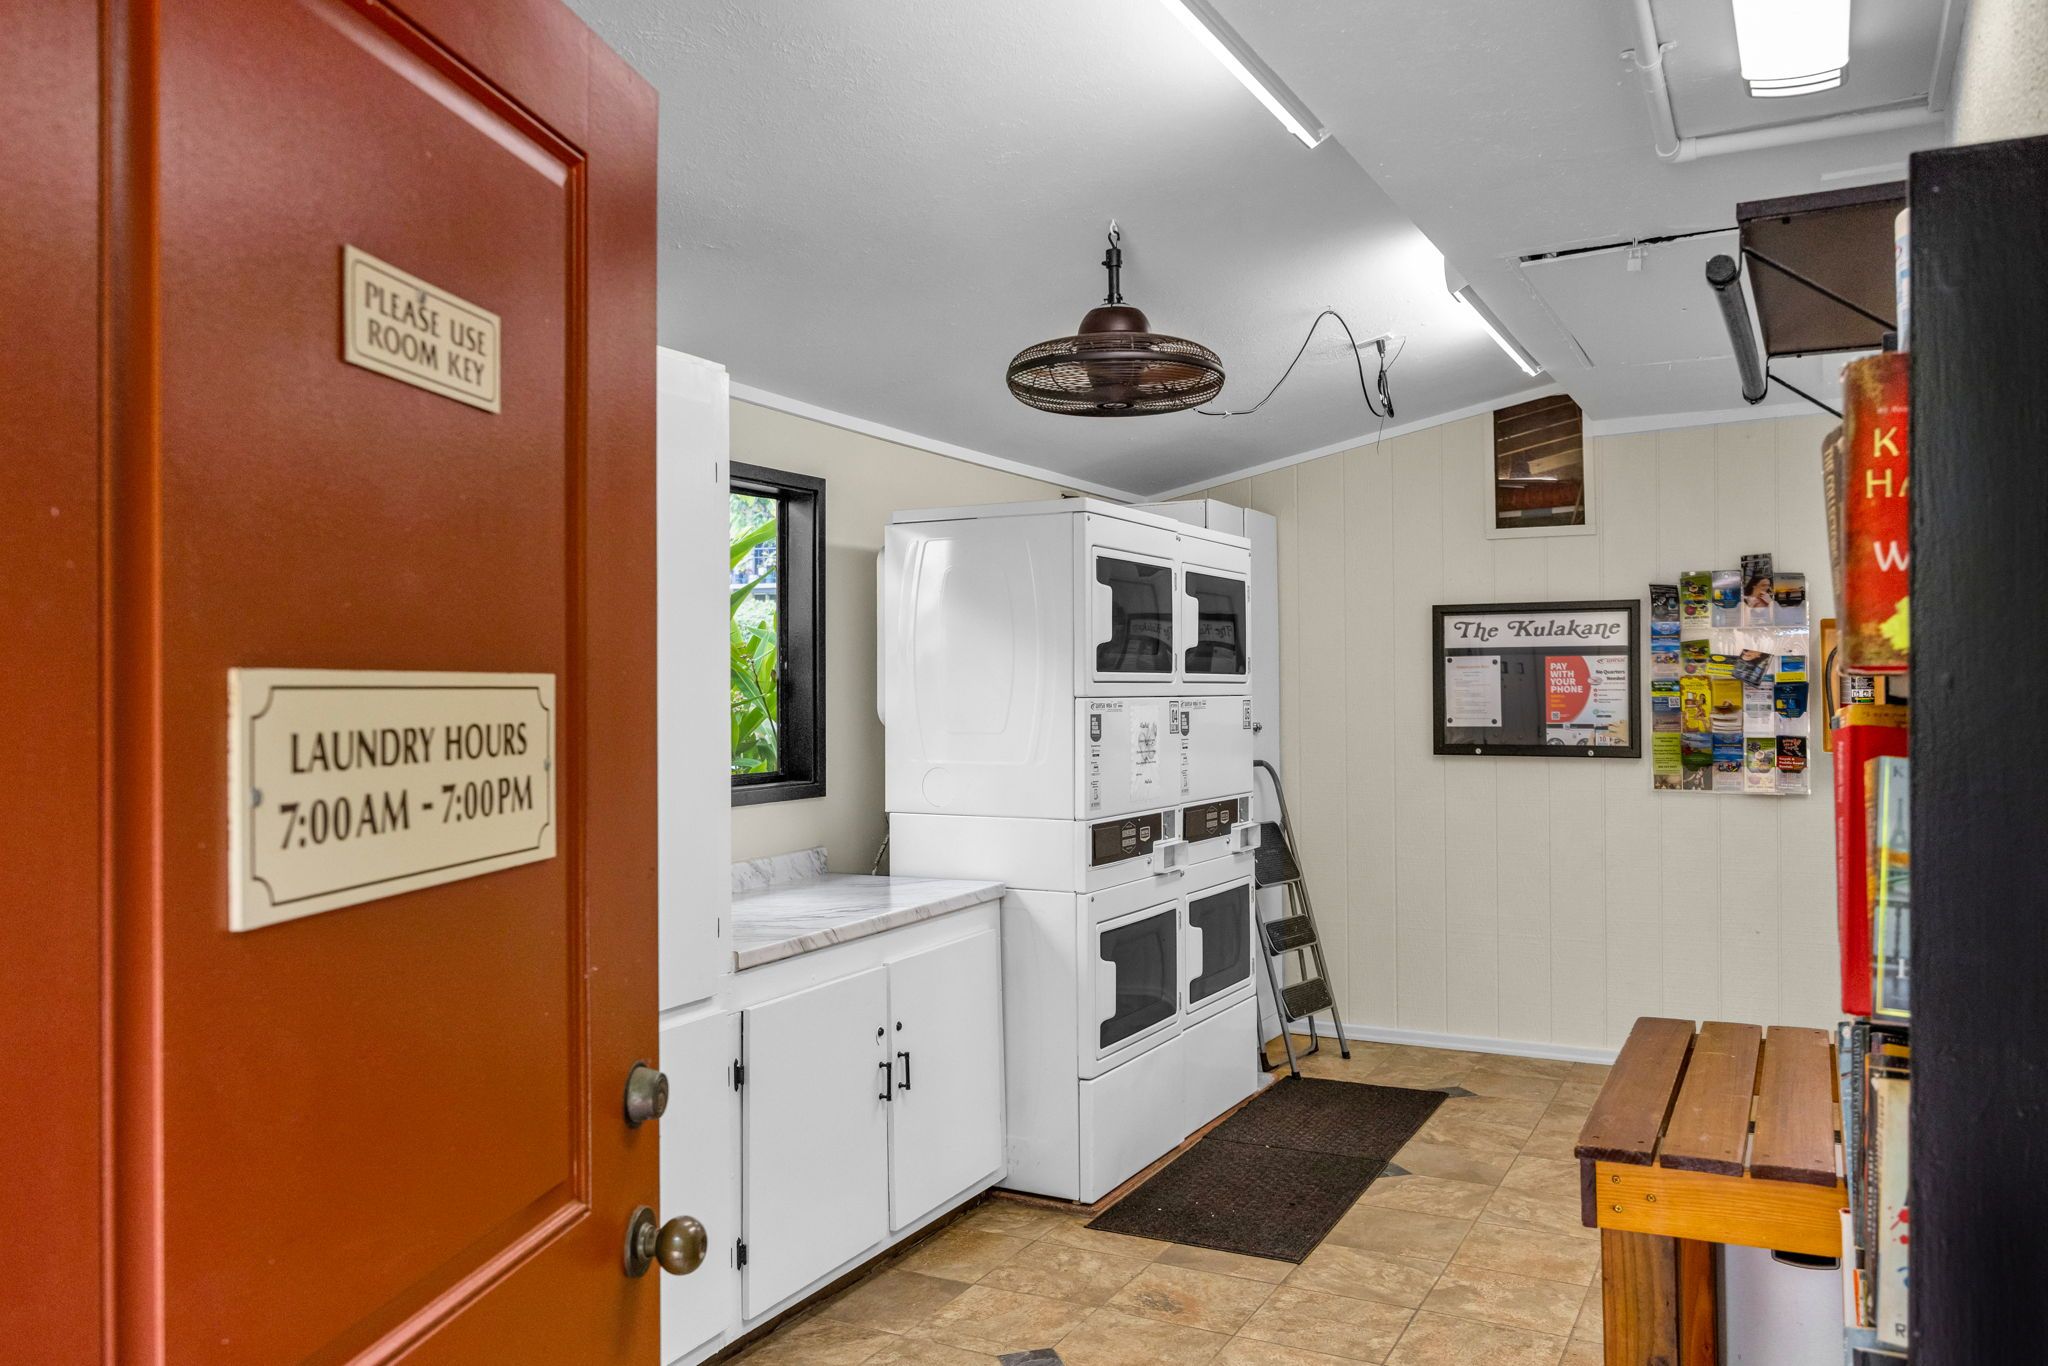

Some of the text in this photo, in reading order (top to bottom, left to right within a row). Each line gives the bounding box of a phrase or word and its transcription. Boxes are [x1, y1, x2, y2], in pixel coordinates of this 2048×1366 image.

[364, 281, 486, 357] PLEASE USE
[368, 318, 484, 387] ROOM KEY
[1453, 619, 1621, 642] The Kulakane
[1550, 662, 1568, 670] PAY
[1550, 670, 1575, 678] WITH
[290, 722, 528, 774] LAUNDRY HOURS
[279, 789, 410, 850] 7:00AM
[442, 775, 533, 824] 7:00PM
